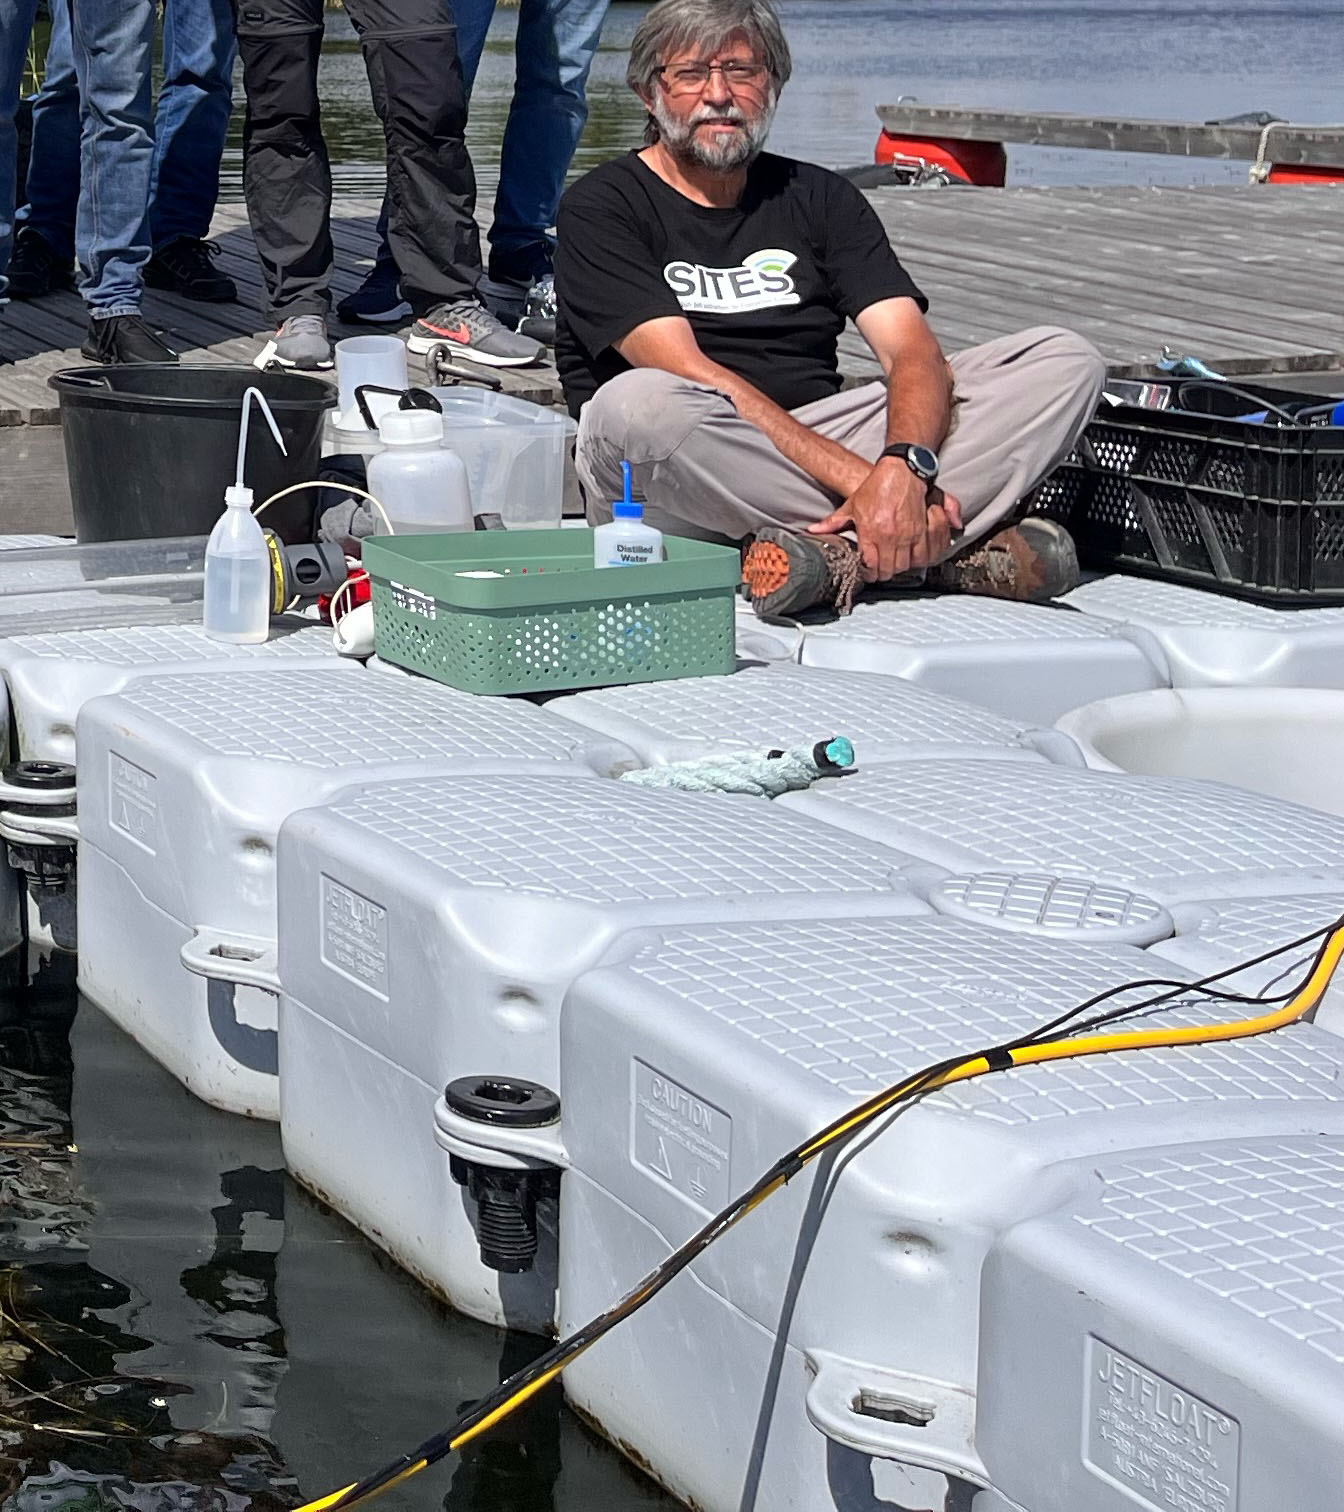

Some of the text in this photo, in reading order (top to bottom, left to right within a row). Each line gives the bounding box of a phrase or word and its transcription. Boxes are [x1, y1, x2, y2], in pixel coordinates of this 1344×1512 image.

[667, 265, 790, 300] SITES
[616, 544, 653, 554] Distilled
[620, 553, 648, 563] Water
[652, 1078, 712, 1134] CAUTION
